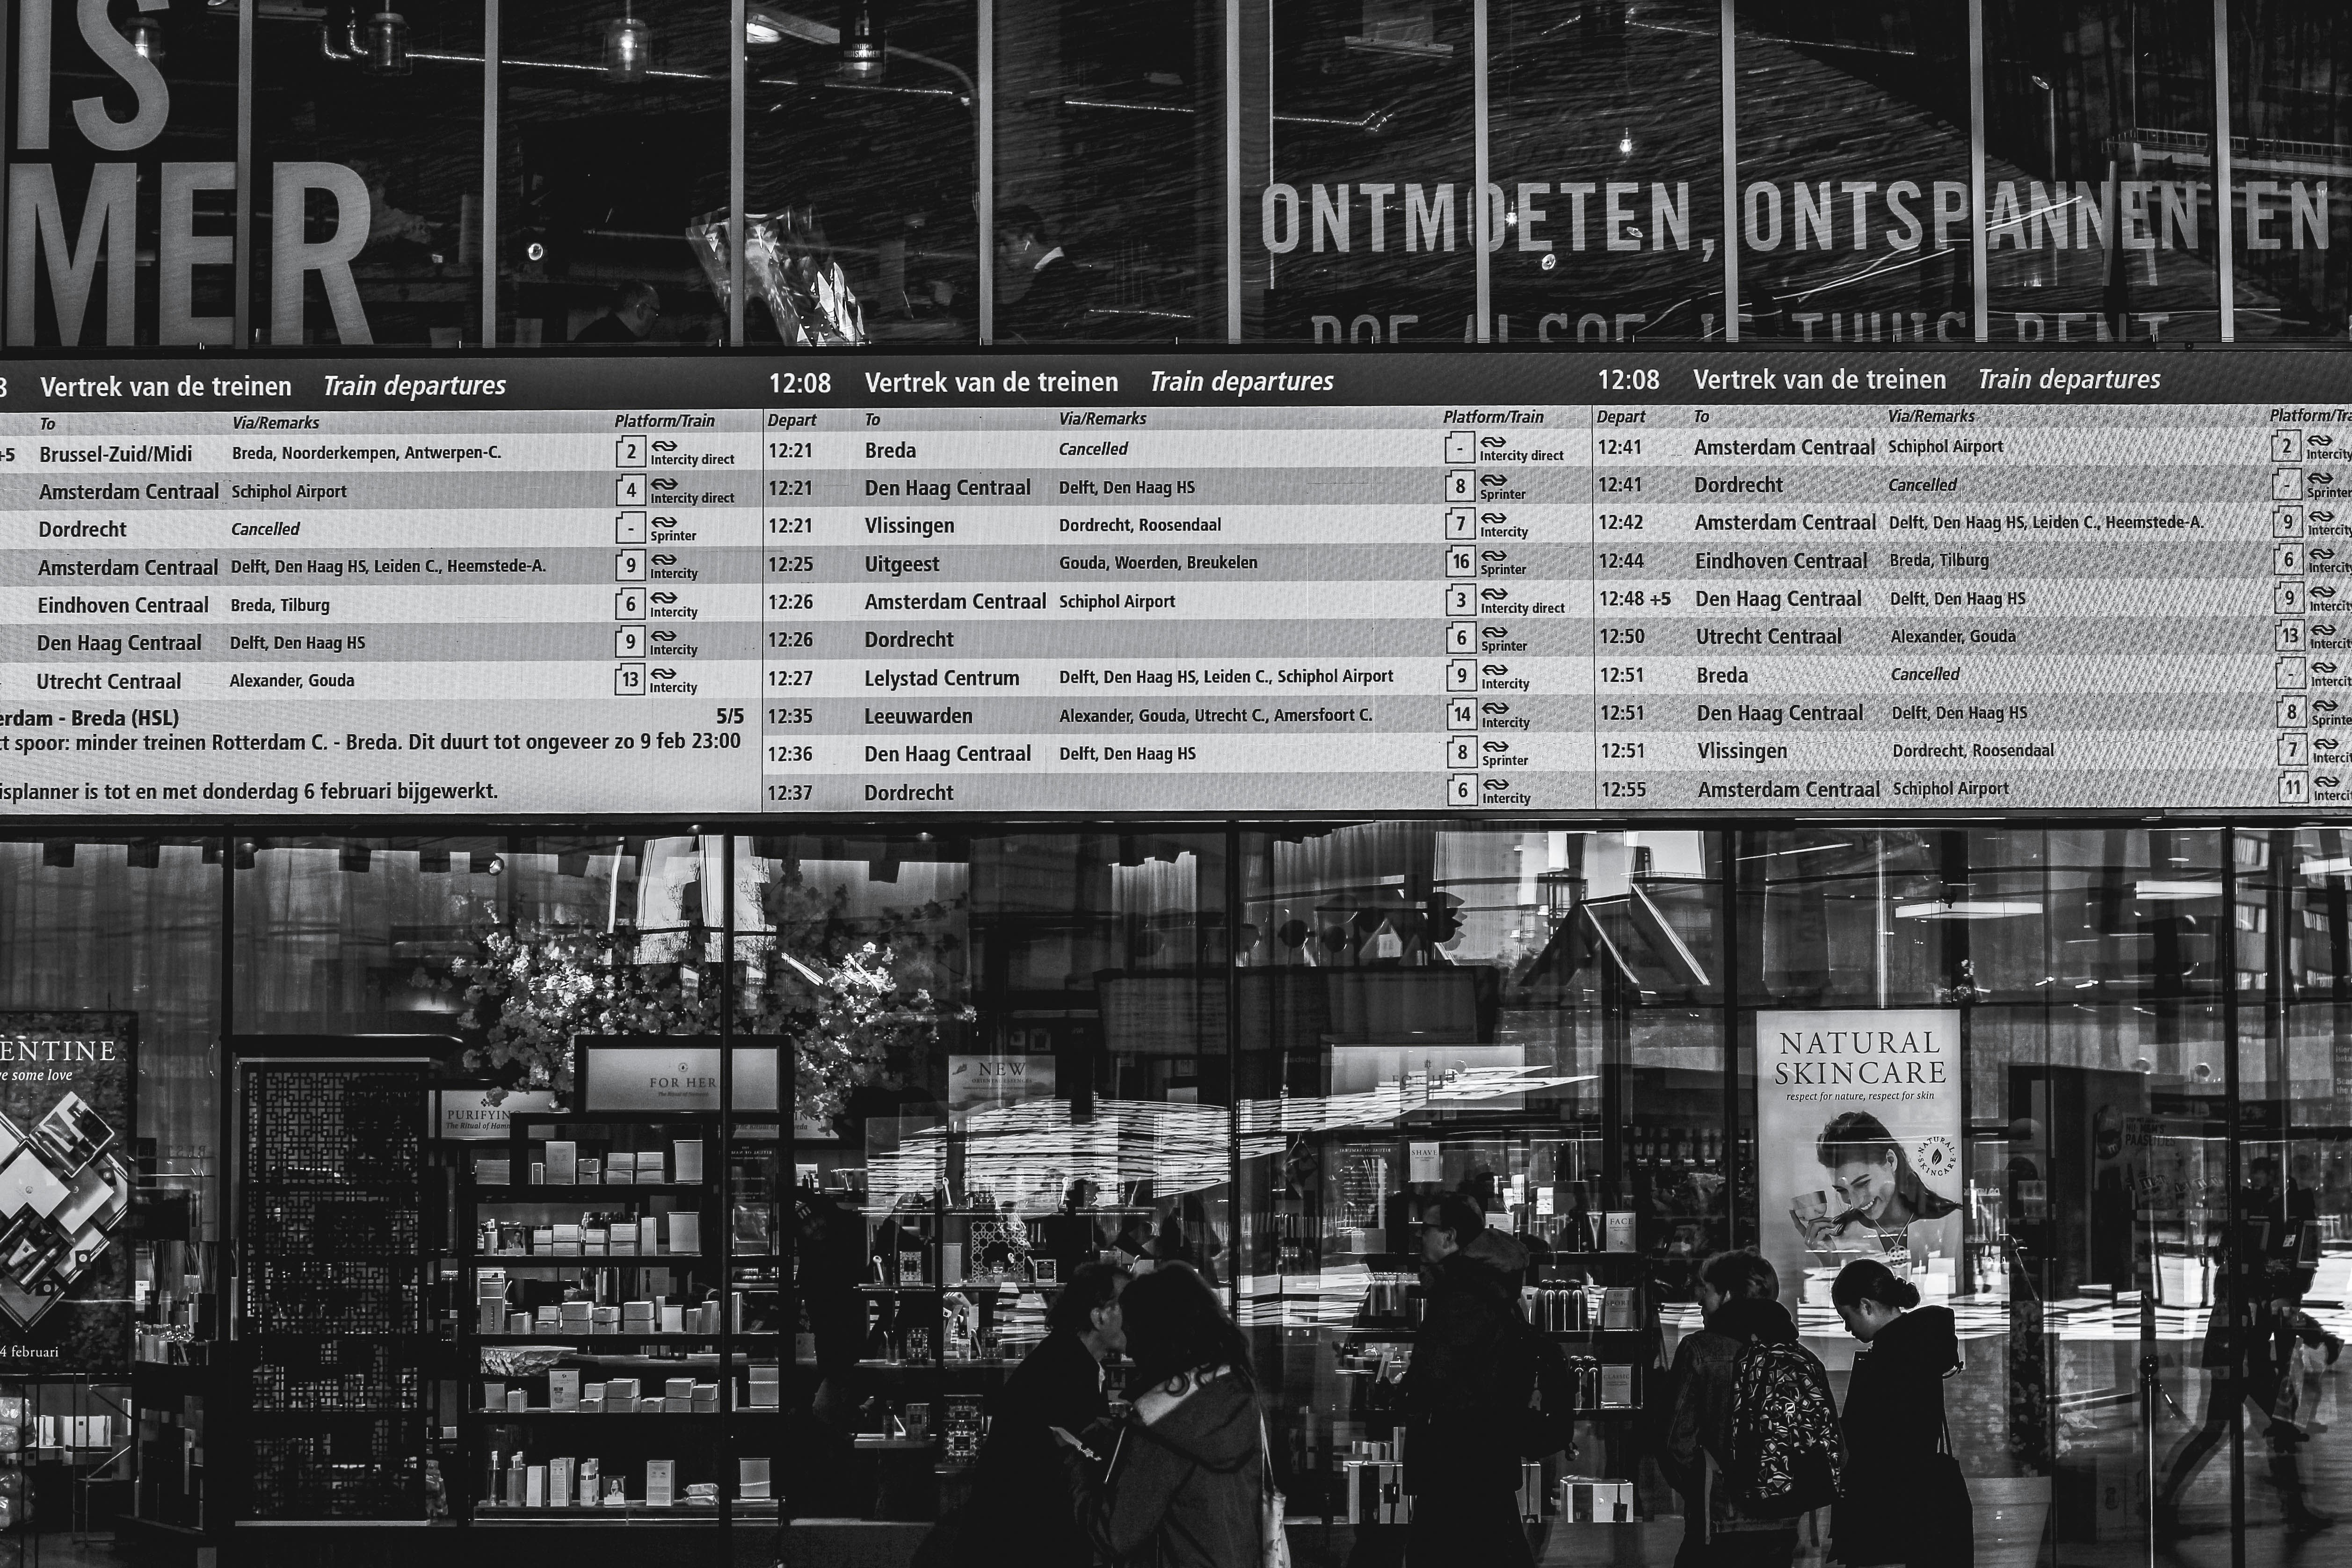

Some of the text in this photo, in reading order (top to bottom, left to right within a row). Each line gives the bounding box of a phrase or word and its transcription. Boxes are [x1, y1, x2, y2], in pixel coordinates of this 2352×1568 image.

[1262, 180, 2329, 262] ONTMOETEN, ONTSPANNEN EN
[7, 162, 373, 346] MER
[40, 375, 291, 397] Vertrek van de treinen
[770, 372, 831, 393] 12:08
[865, 370, 1118, 392] Vertrek van de treinen
[1151, 370, 1334, 397] Train departures
[1599, 369, 1660, 390] 12:08
[1693, 368, 1946, 389] Vertrek van de treinen
[1980, 367, 2161, 395] Train departures
[325, 374, 506, 401] Train departures
[41, 417, 56, 430] To
[233, 415, 319, 429] Via/Remarks
[615, 414, 715, 428] Platform/Train
[768, 414, 817, 430] Depart
[866, 413, 880, 426] To
[1060, 411, 1147, 425] Via/Remarks
[1443, 409, 1544, 423] Platform/Train
[627, 444, 636, 459] 2
[1599, 439, 1641, 455] 12:41
[1694, 437, 1875, 455] Amsterdam Centraal
[1888, 439, 2004, 457] Schiphol Airport
[2283, 437, 2291, 453] 2
[40, 444, 192, 463] Brussel-Zuid/Midi
[233, 445, 501, 464] Breda, Noorderkempen, Antwerpen-C.
[651, 453, 734, 468] Intercity direct
[769, 518, 811, 533] 12:21
[865, 516, 954, 538] Vlissingen
[1060, 517, 1221, 533] Dordrecht, Roosendaal
[1457, 516, 1465, 531] 7
[1481, 527, 1529, 540] Intercity
[769, 556, 813, 572] 12:25
[865, 555, 940, 577] Uitgeest
[1060, 555, 1258, 571] Gouda, Woerden, Breukelen
[1453, 553, 1469, 569] 16
[1481, 565, 1527, 578] Sprinter
[38, 595, 209, 613] Eindhoven Centraal
[626, 596, 636, 611] 6
[1600, 590, 1671, 606] 12:48 +5
[1696, 589, 1862, 612] Den Haag Centraal
[1891, 591, 2026, 609] Delft, Den Haag HS
[232, 597, 330, 616] Breda, Tilburg
[651, 607, 698, 620] Intercity
[72, 709, 125, 726] Breda
[132, 709, 179, 729] (HSL)
[717, 708, 744, 724] 5/5
[769, 708, 813, 724] 12:35
[865, 706, 973, 724] Leeuwarden
[1060, 707, 1372, 724] Alexander, Gouda, Utrecht C., Amersfoort C.
[1454, 706, 1471, 722] 14
[1482, 718, 1530, 731] Intercity
[15, 739, 69, 755] spoor:
[76, 733, 138, 751] minder
[143, 733, 206, 750] treinen
[212, 733, 305, 750] Rotterdam
[312, 734, 327, 750] C.
[347, 733, 402, 750] Breda.
[409, 733, 435, 750] Dit
[441, 733, 489, 750] duurt
[494, 734, 521, 749] tot
[526, 737, 609, 755] ongeveer
[615, 737, 634, 749] zo
[640, 733, 651, 749] 9
[656, 732, 685, 749] feb
[692, 732, 740, 749] 23:00
[1602, 743, 1644, 758] 12:51
[1893, 742, 2054, 759] Dordrecht, Roosendaal
[1697, 741, 1787, 763] Vlissingen
[1779, 1031, 1940, 1054] NATURAL
[12, 1072, 44, 1081] some
[48, 1068, 73, 1081] love
[979, 1062, 1026, 1076] NEW
[1775, 1061, 1946, 1085] SKINCARE
[650, 1078, 717, 1088] FOR HER
[1786, 1091, 1935, 1103] respect for nature, respect for skin
[448, 1110, 521, 1120] PURIFYIN
[1918, 1135, 1956, 1154] NATURAL
[1917, 1156, 1957, 1177] SKINCARE
[12, 1345, 58, 1357] februari
